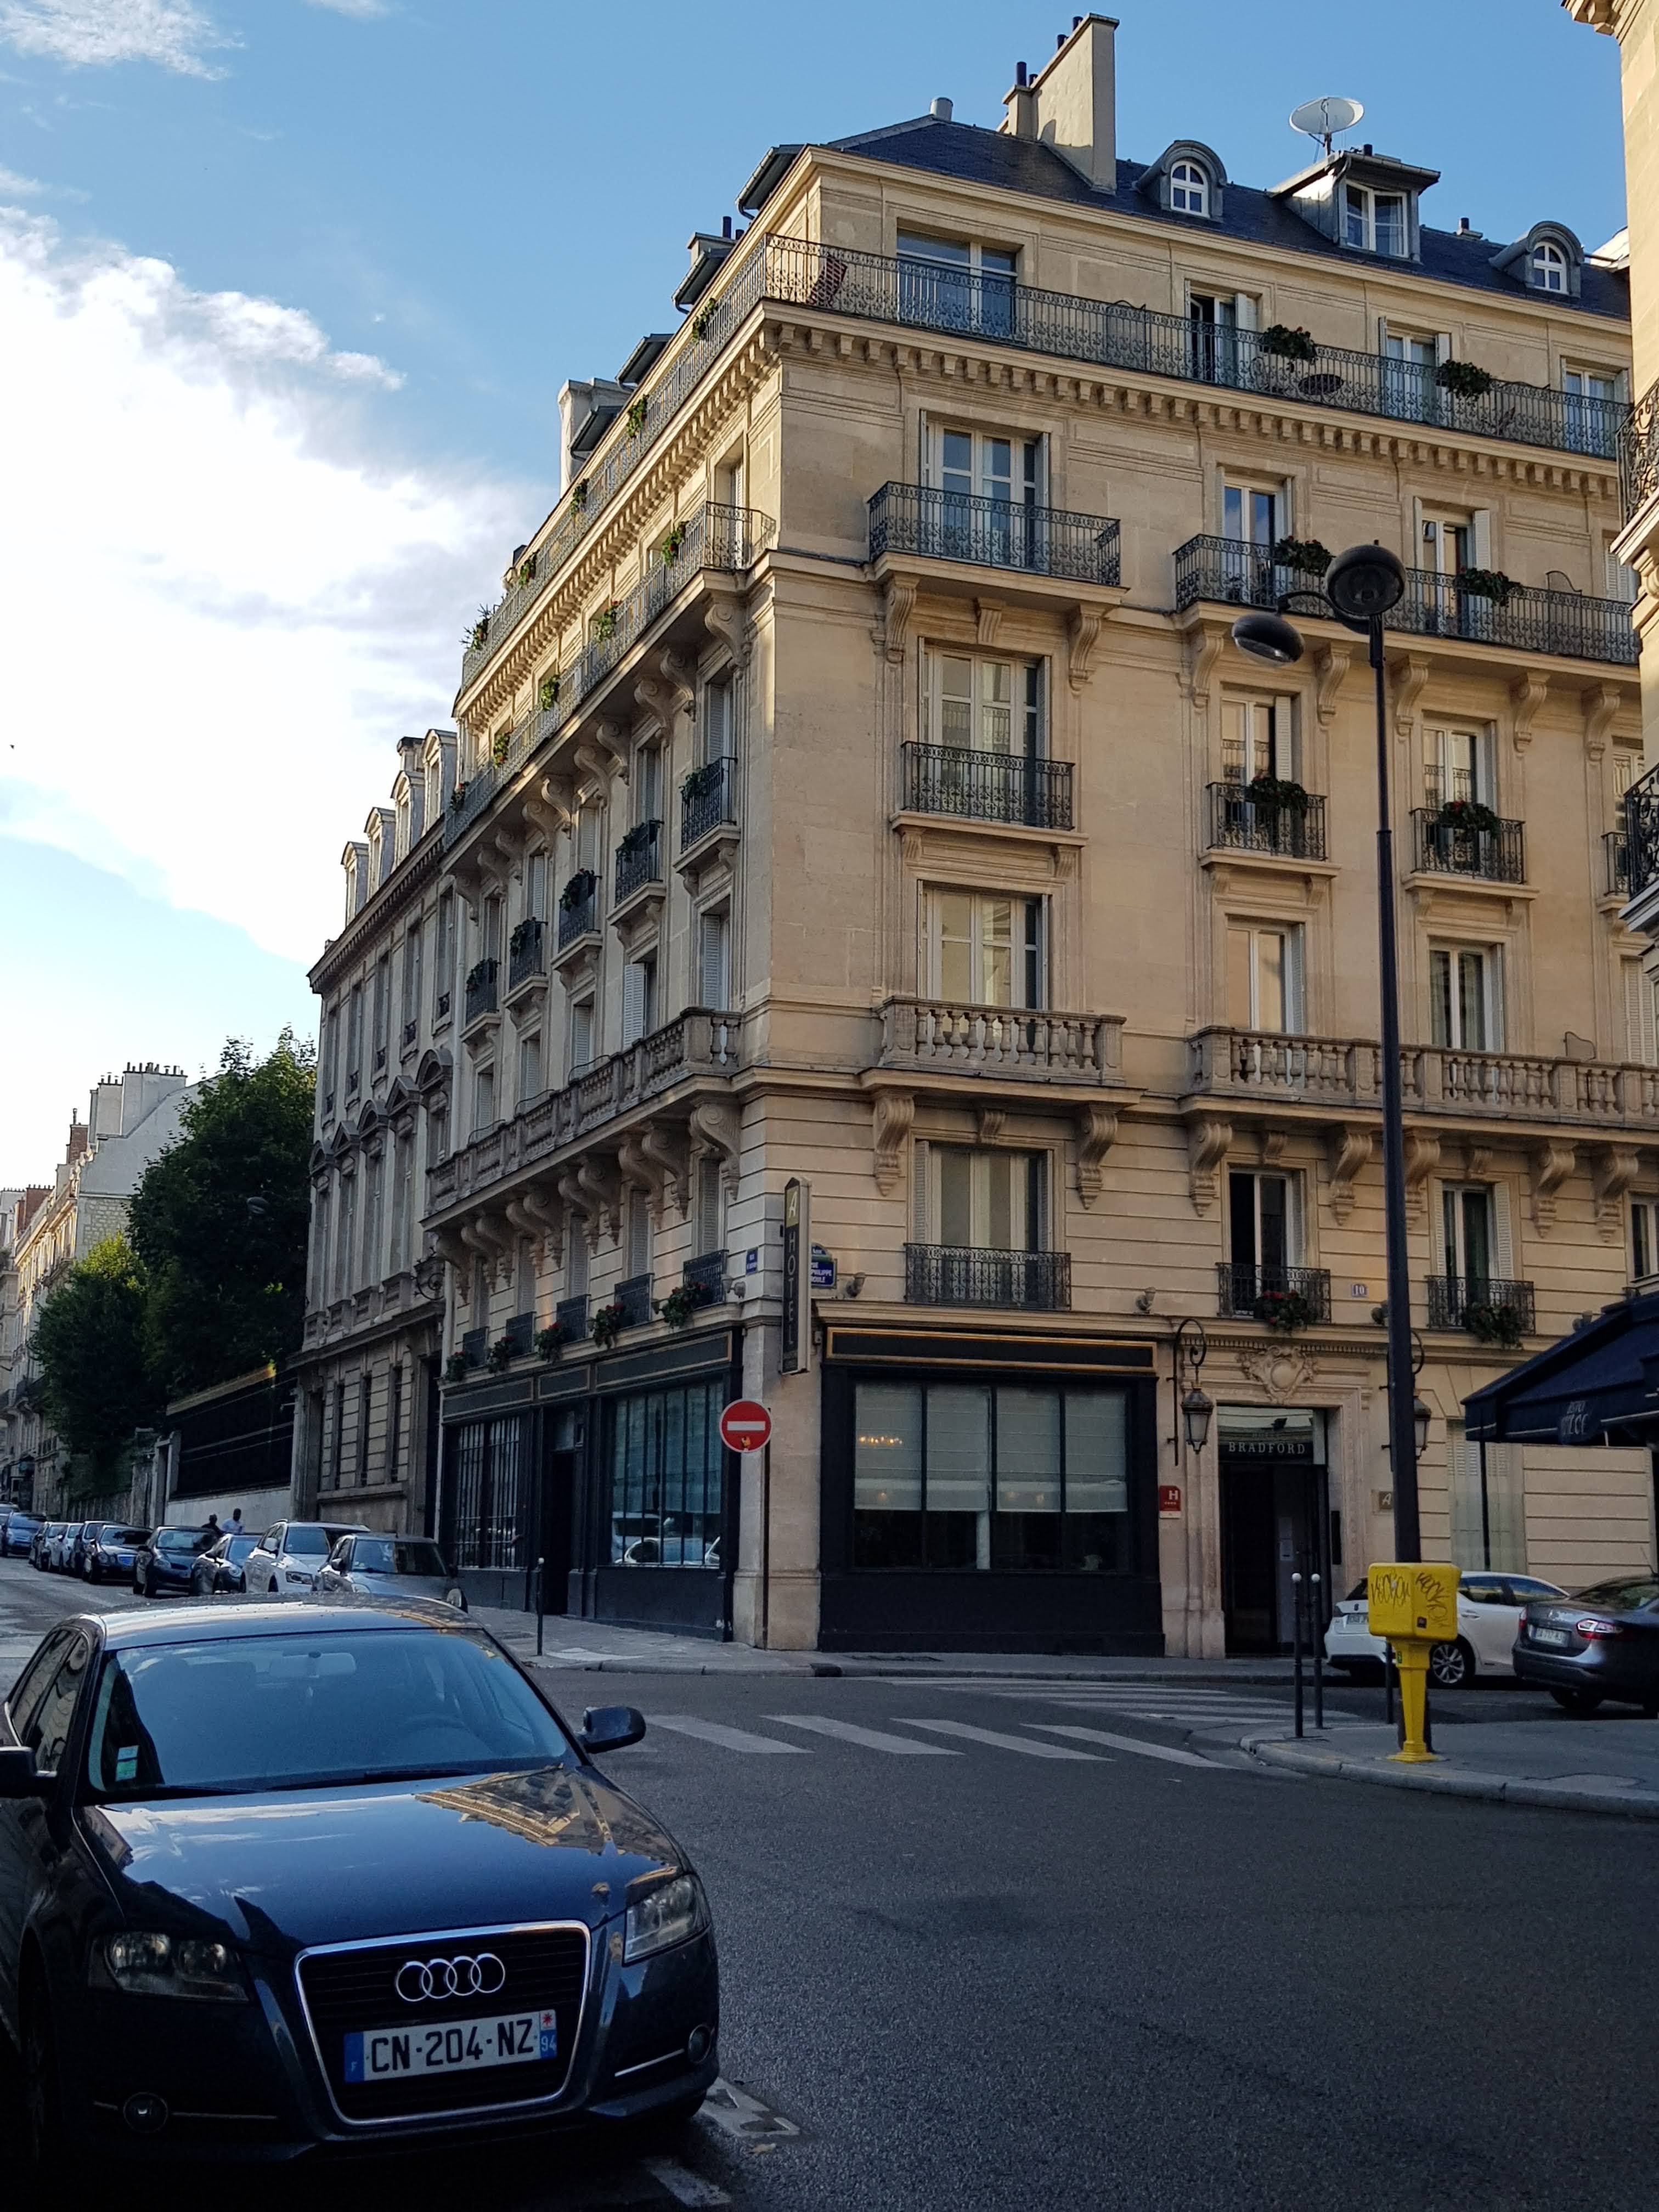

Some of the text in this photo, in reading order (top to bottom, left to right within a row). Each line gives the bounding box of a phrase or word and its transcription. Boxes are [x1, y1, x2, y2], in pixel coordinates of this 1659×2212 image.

[788, 1191, 798, 1218] A
[787, 1231, 796, 1344] HOTEL
[1355, 1285, 1364, 1295] 10
[1228, 1441, 1305, 1454] BRADFORD
[1169, 1490, 1178, 1500] H
[351, 2019, 556, 2073] F CN-204-NZ 94
